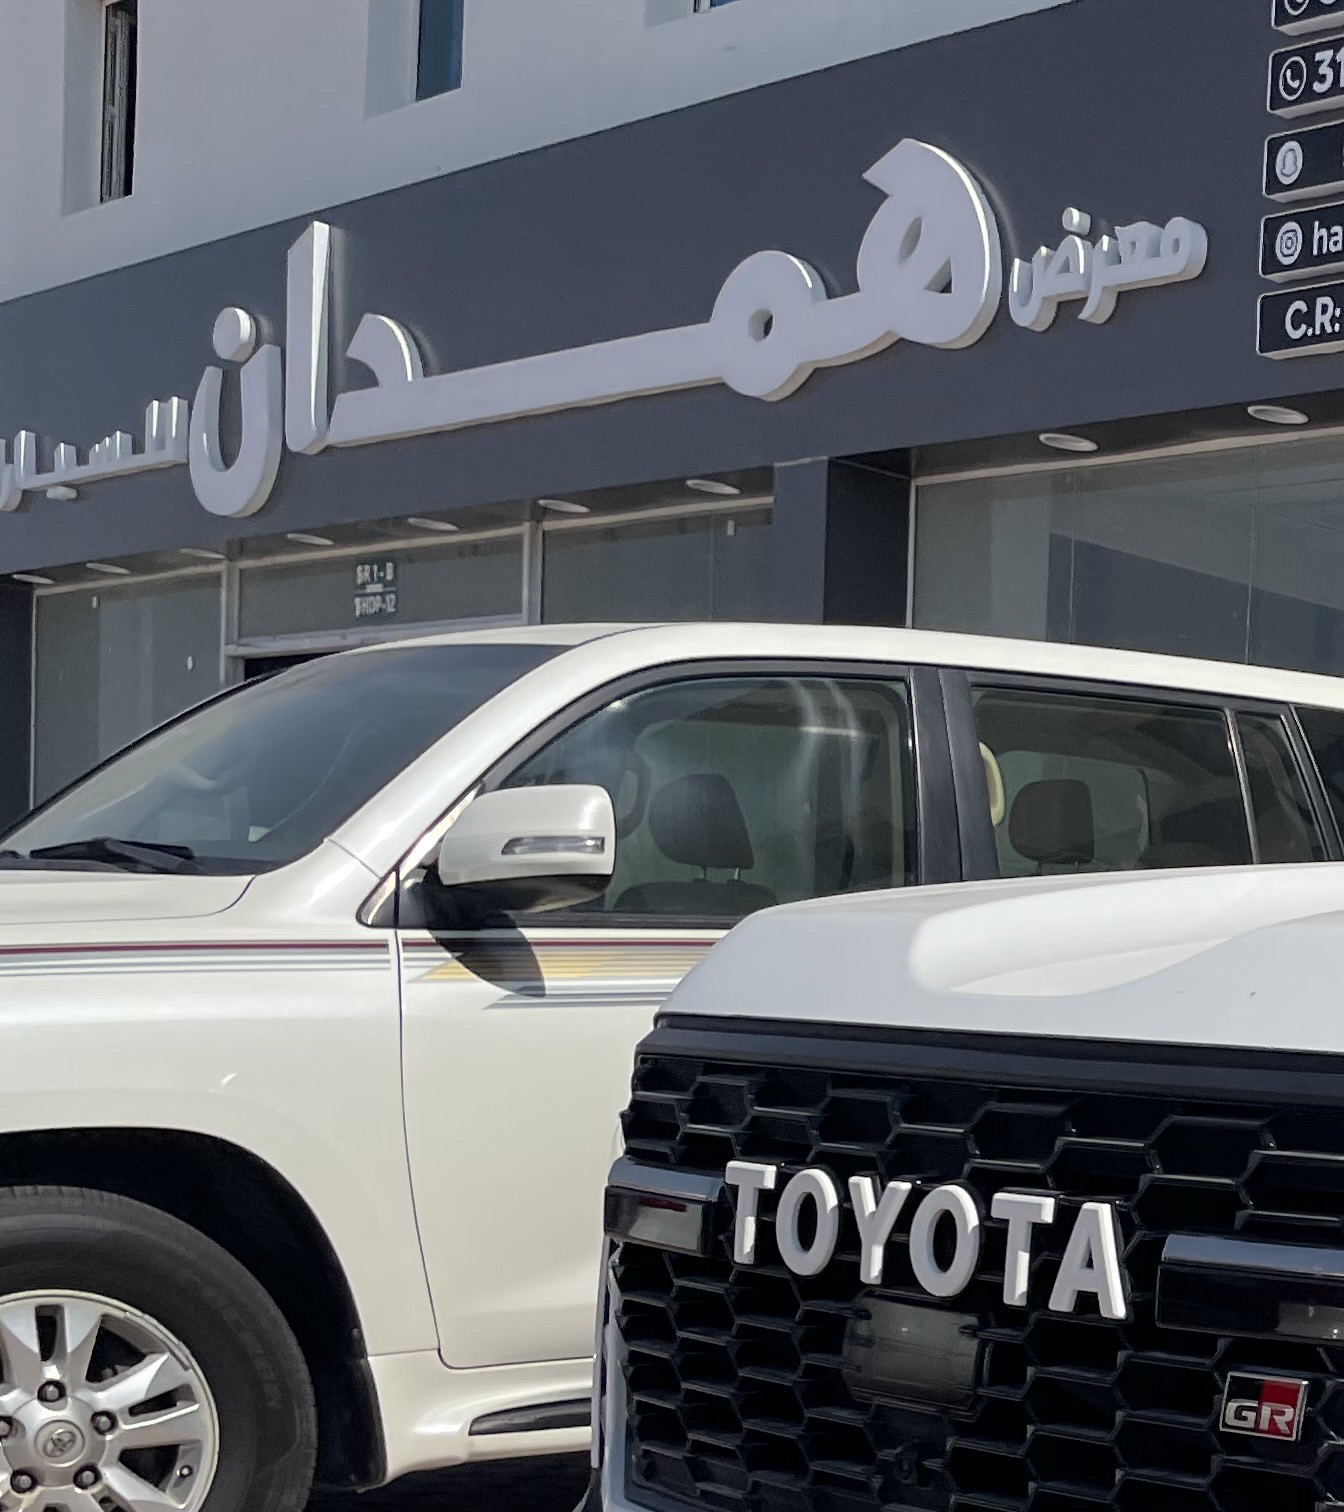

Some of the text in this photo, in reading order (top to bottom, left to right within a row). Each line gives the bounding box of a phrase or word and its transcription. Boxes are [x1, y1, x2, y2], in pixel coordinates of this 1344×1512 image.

[190, 138, 1001, 518] همدان
[1009, 207, 1208, 332] معرض
[1285, 297, 1341, 339] C.R:
[725, 1160, 1129, 1319] TOYOTA
[1225, 1399, 1295, 1435] GR
